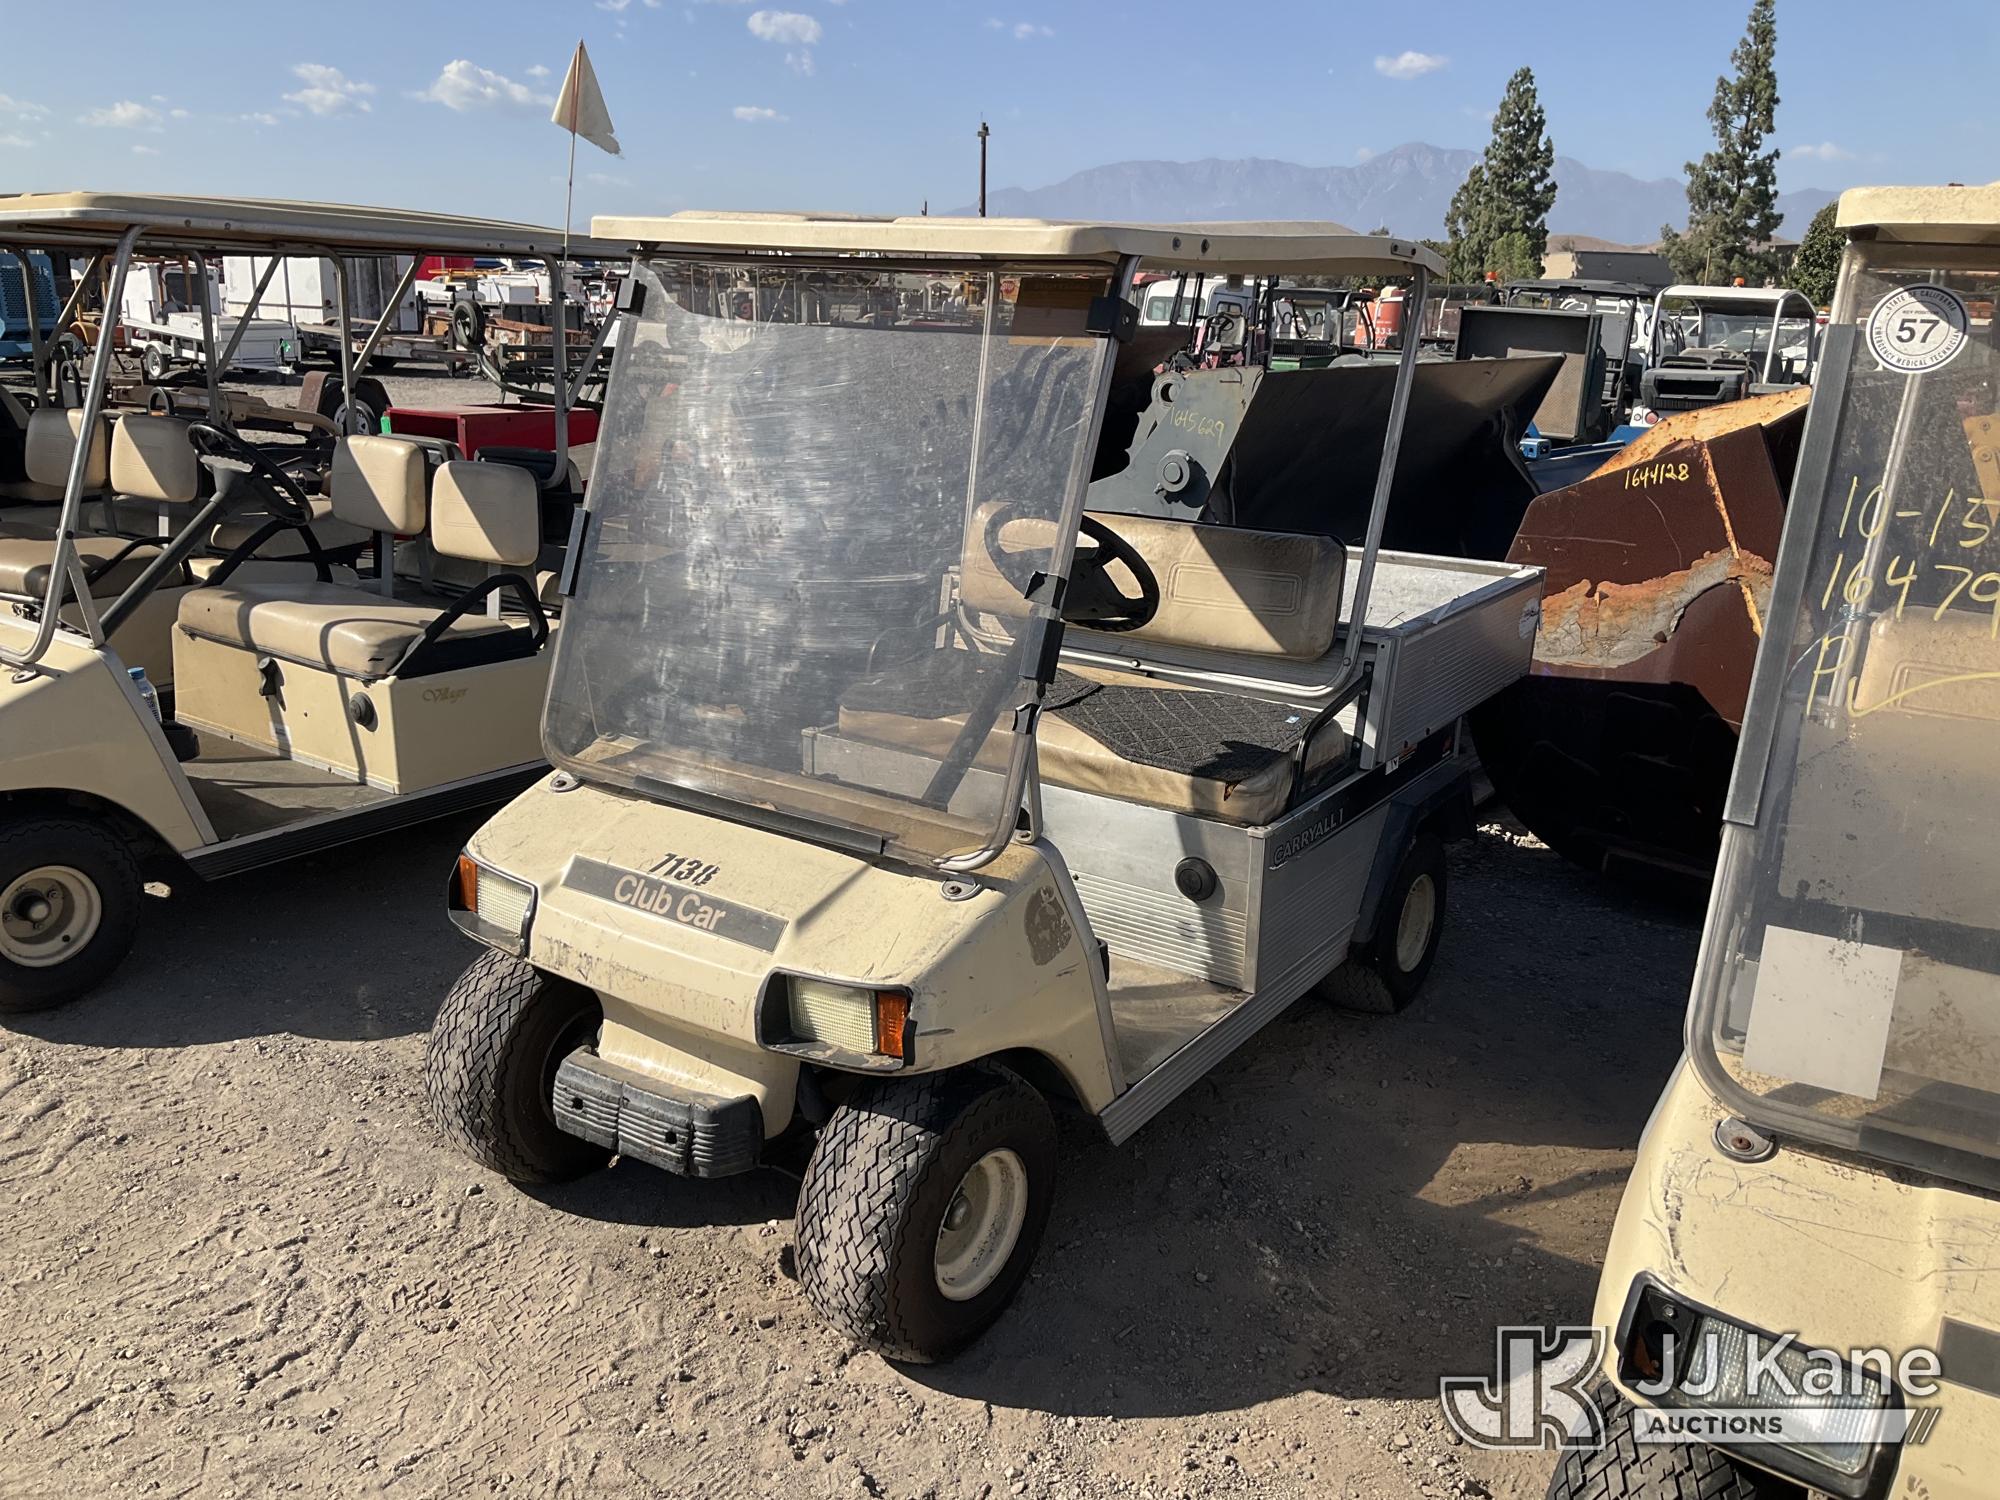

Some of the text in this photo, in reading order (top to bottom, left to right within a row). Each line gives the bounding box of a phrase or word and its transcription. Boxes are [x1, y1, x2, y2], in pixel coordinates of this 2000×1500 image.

[1887, 294, 1906, 311] STATE
[1920, 290, 1957, 311] CALIFORNIA
[1874, 326, 1961, 367] EMERGENCY MEDICAL TECHNICIAN
[1896, 318, 1940, 343] 57
[1169, 407, 1225, 448] 1645629
[1624, 463, 1690, 490] 1644128
[1274, 813, 1337, 864] CARRYALL
[614, 874, 727, 931] Club Car
